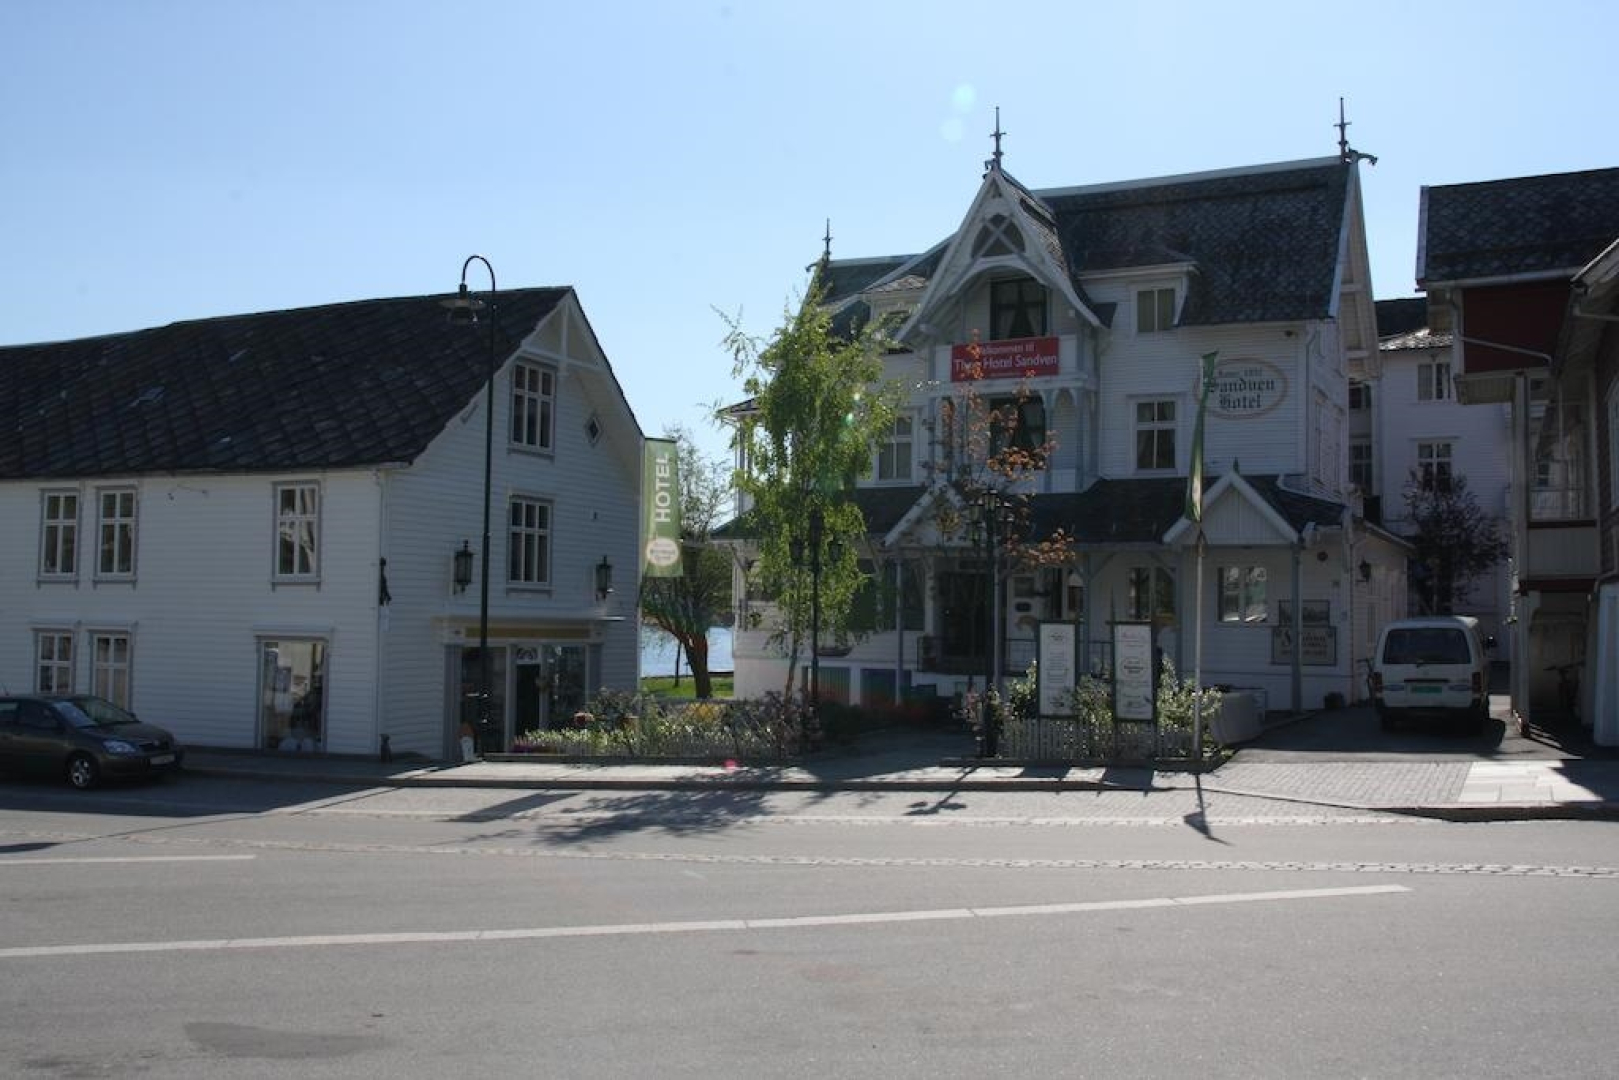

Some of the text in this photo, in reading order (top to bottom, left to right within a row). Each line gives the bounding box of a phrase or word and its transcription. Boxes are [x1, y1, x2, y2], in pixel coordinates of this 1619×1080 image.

[982, 355, 1013, 368] Hotel
[1014, 353, 1057, 367] Sandven
[1219, 393, 1261, 409] Hotel
[654, 452, 671, 523] HOTEL
